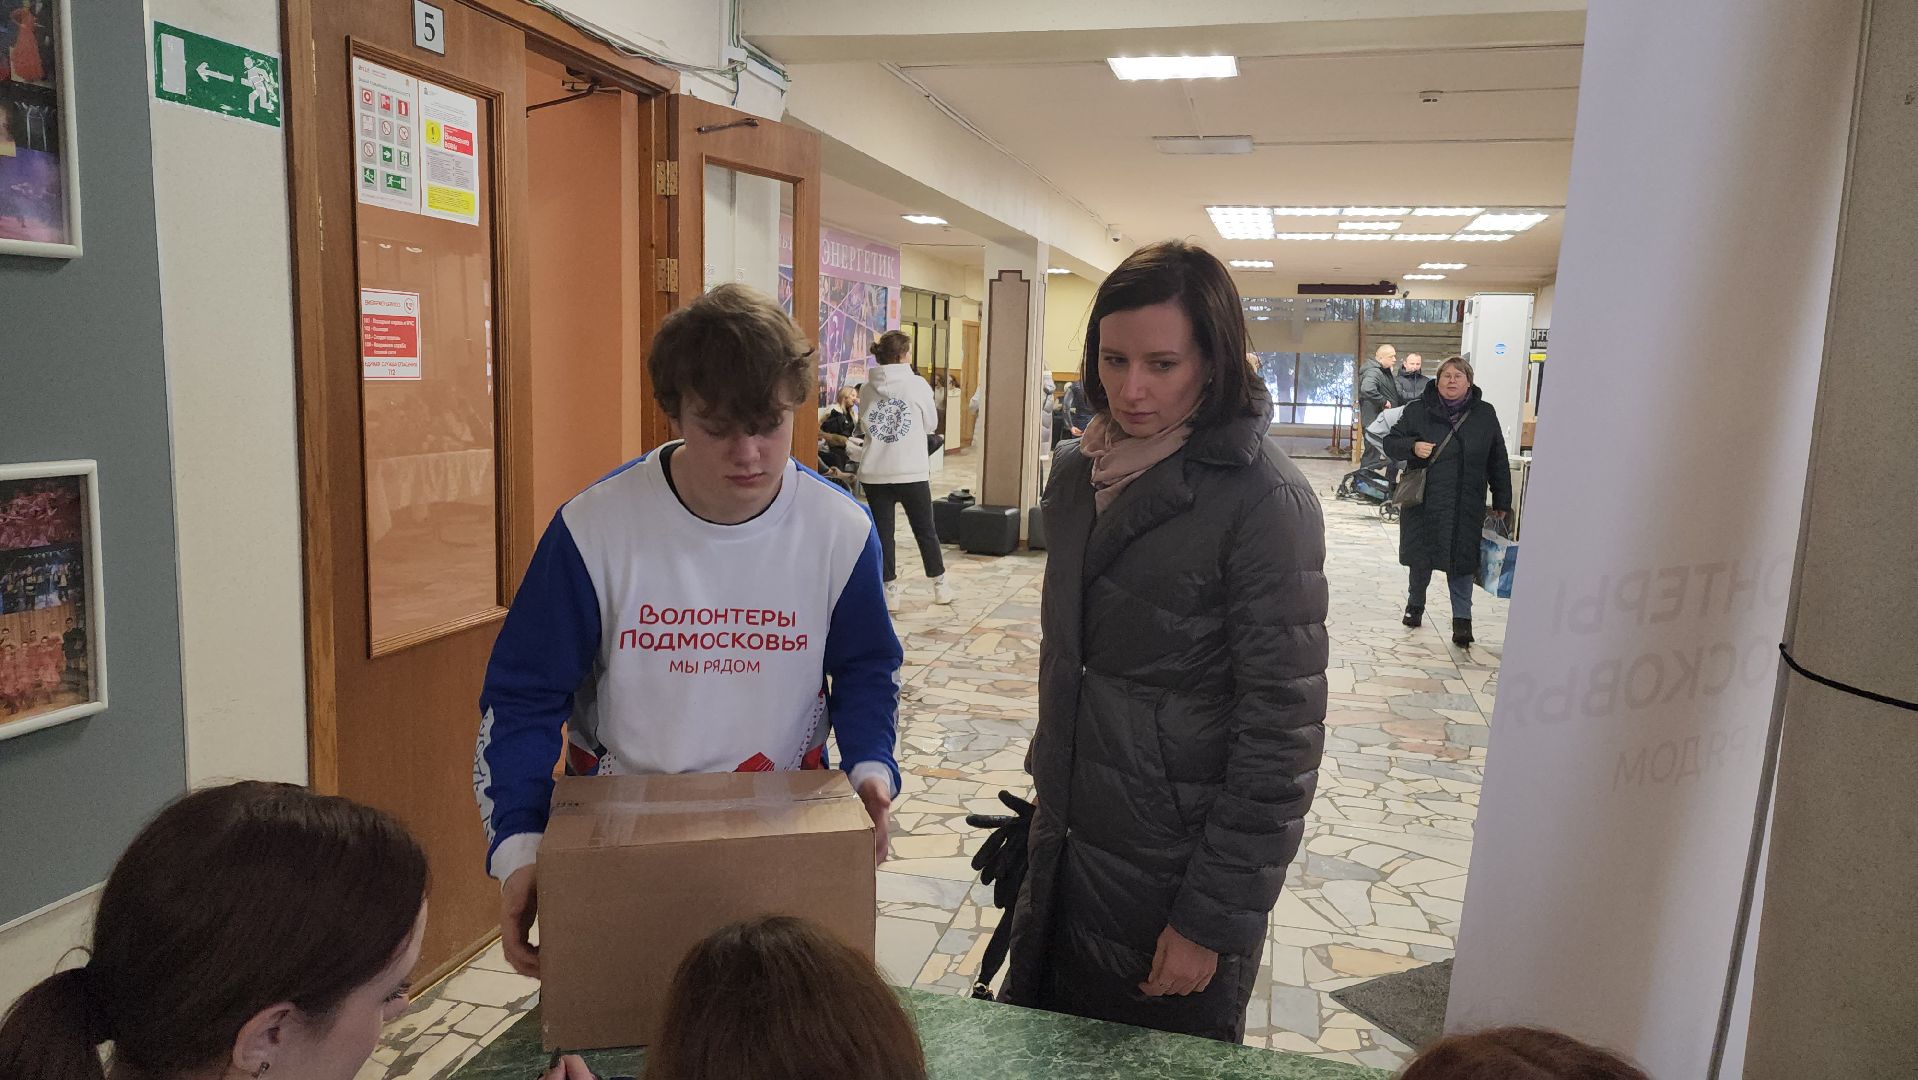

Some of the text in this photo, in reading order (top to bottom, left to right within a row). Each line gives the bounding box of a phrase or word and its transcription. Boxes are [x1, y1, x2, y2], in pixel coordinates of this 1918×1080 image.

[424, 11, 436, 42] 5
[821, 237, 896, 280] ЭНЕРГЕТИК
[638, 604, 796, 628] ВОЛОНТЕРЫ
[619, 628, 808, 652] ПОДМОСКОВЬЯ
[669, 659, 761, 675] МЫ РЯДОМ
